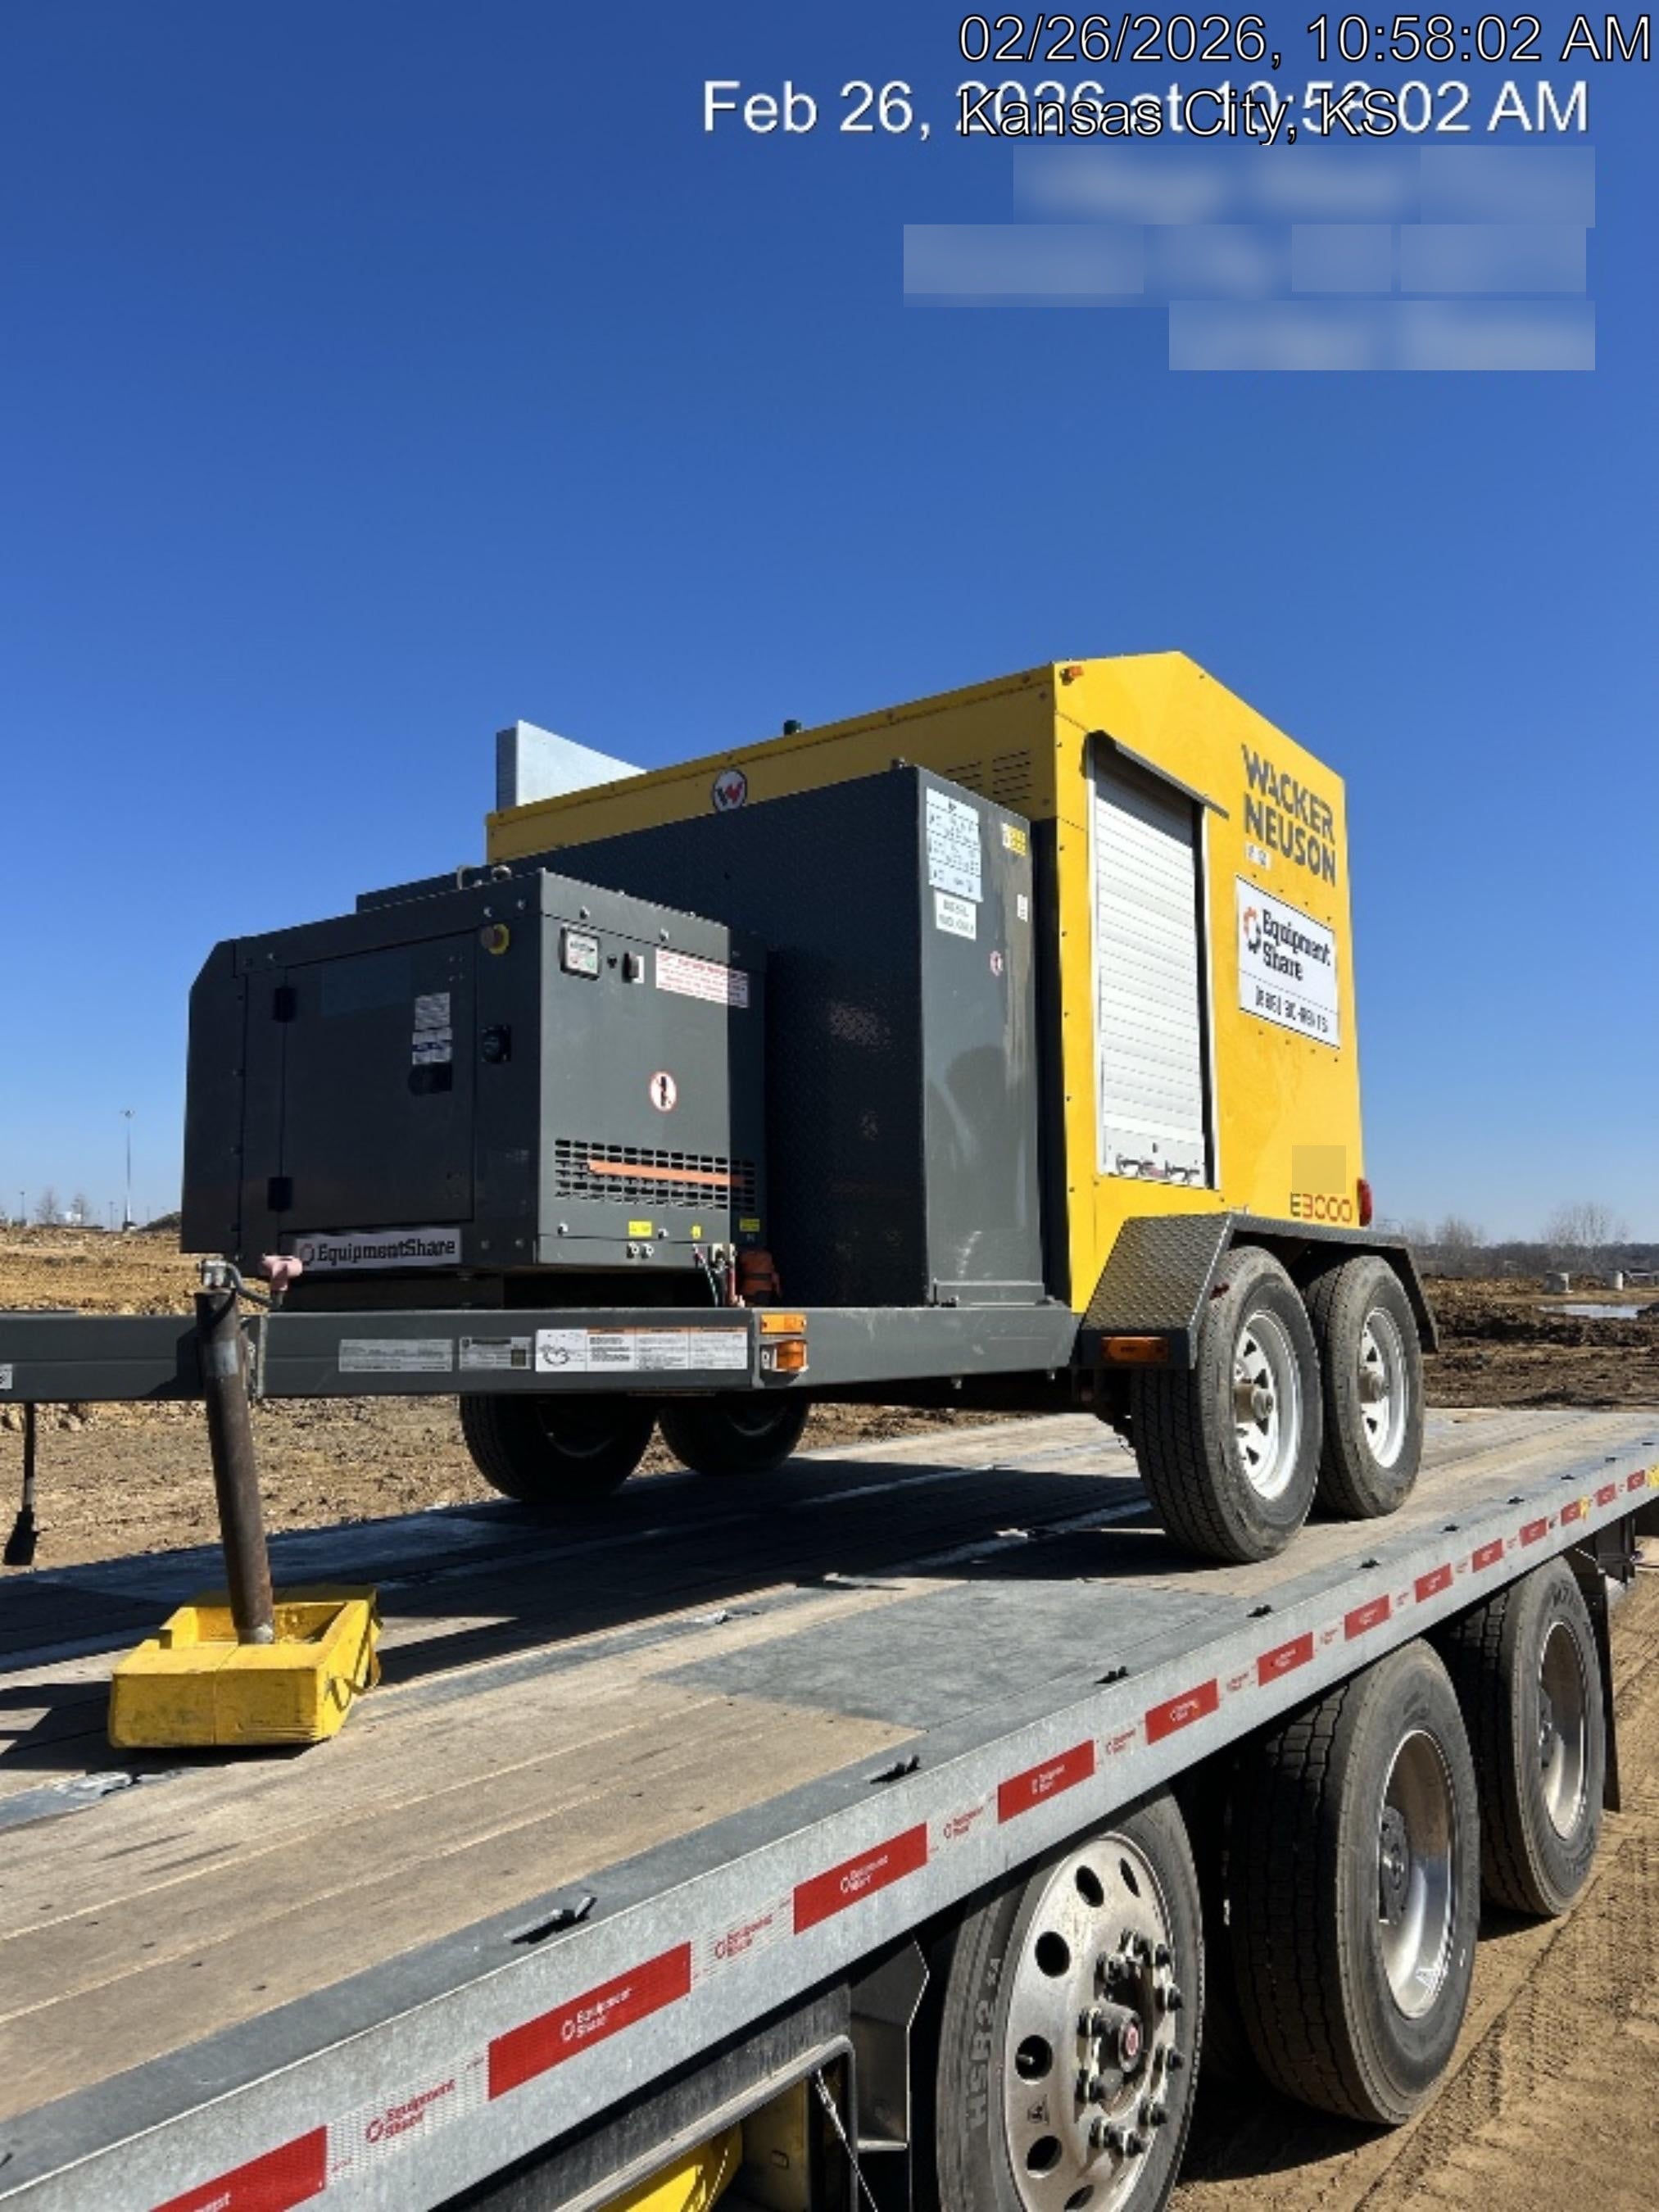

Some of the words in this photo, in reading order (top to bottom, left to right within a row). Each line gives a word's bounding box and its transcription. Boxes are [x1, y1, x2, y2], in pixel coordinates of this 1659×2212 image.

[1241, 743, 1335, 845] WACKER
[1244, 792, 1336, 887] NEUSON
[1290, 1193, 1353, 1223] E3000
[317, 1238, 456, 1266] EquipmentShare
